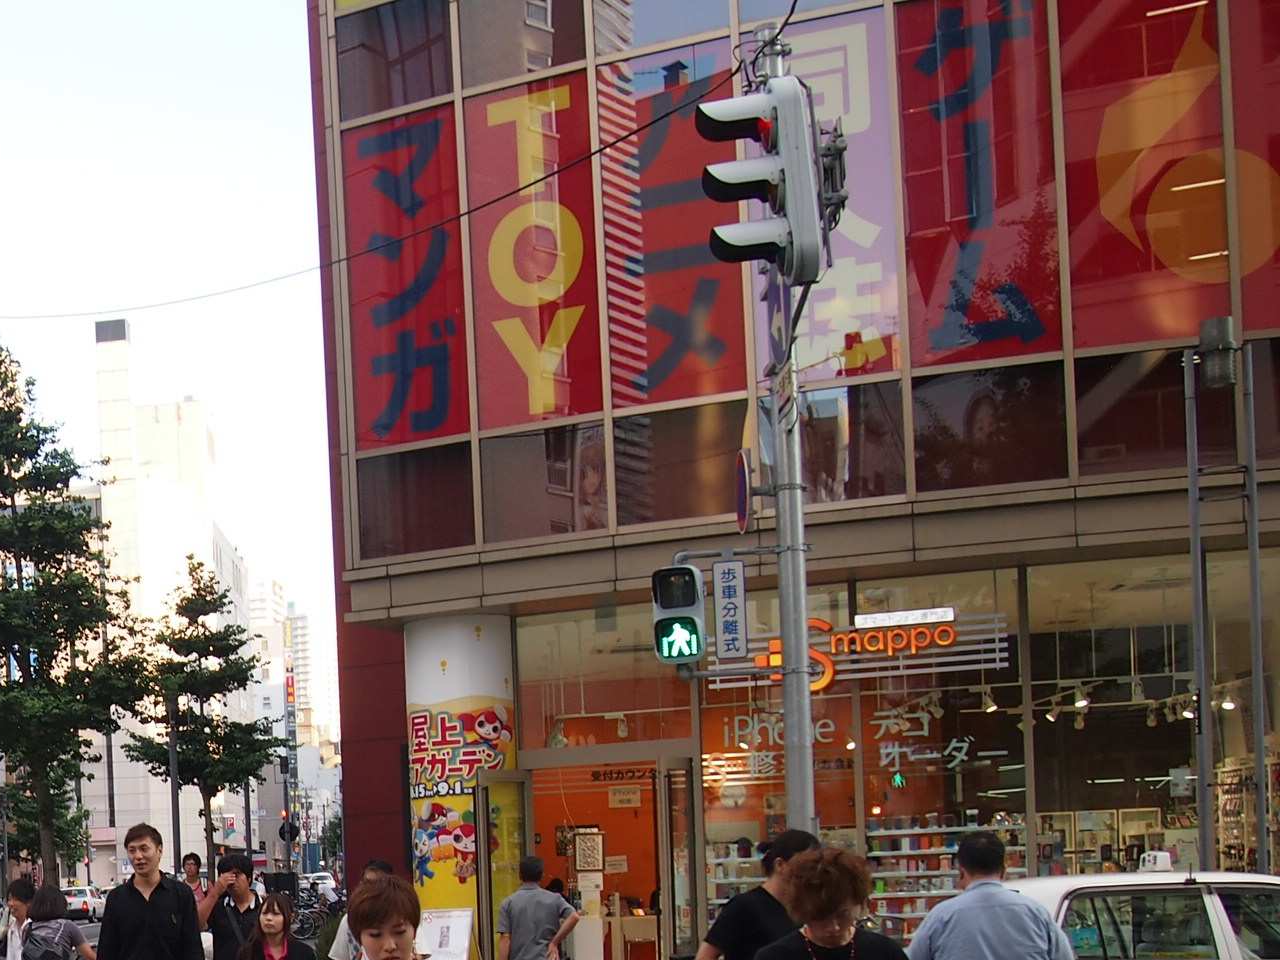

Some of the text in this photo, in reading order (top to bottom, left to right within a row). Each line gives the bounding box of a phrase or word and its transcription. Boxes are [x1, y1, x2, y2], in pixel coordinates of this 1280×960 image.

[357, 117, 457, 438] マンガ
[486, 84, 586, 416] TOY
[721, 568, 742, 654] 歩車分離式
[410, 712, 462, 754] 屋上
